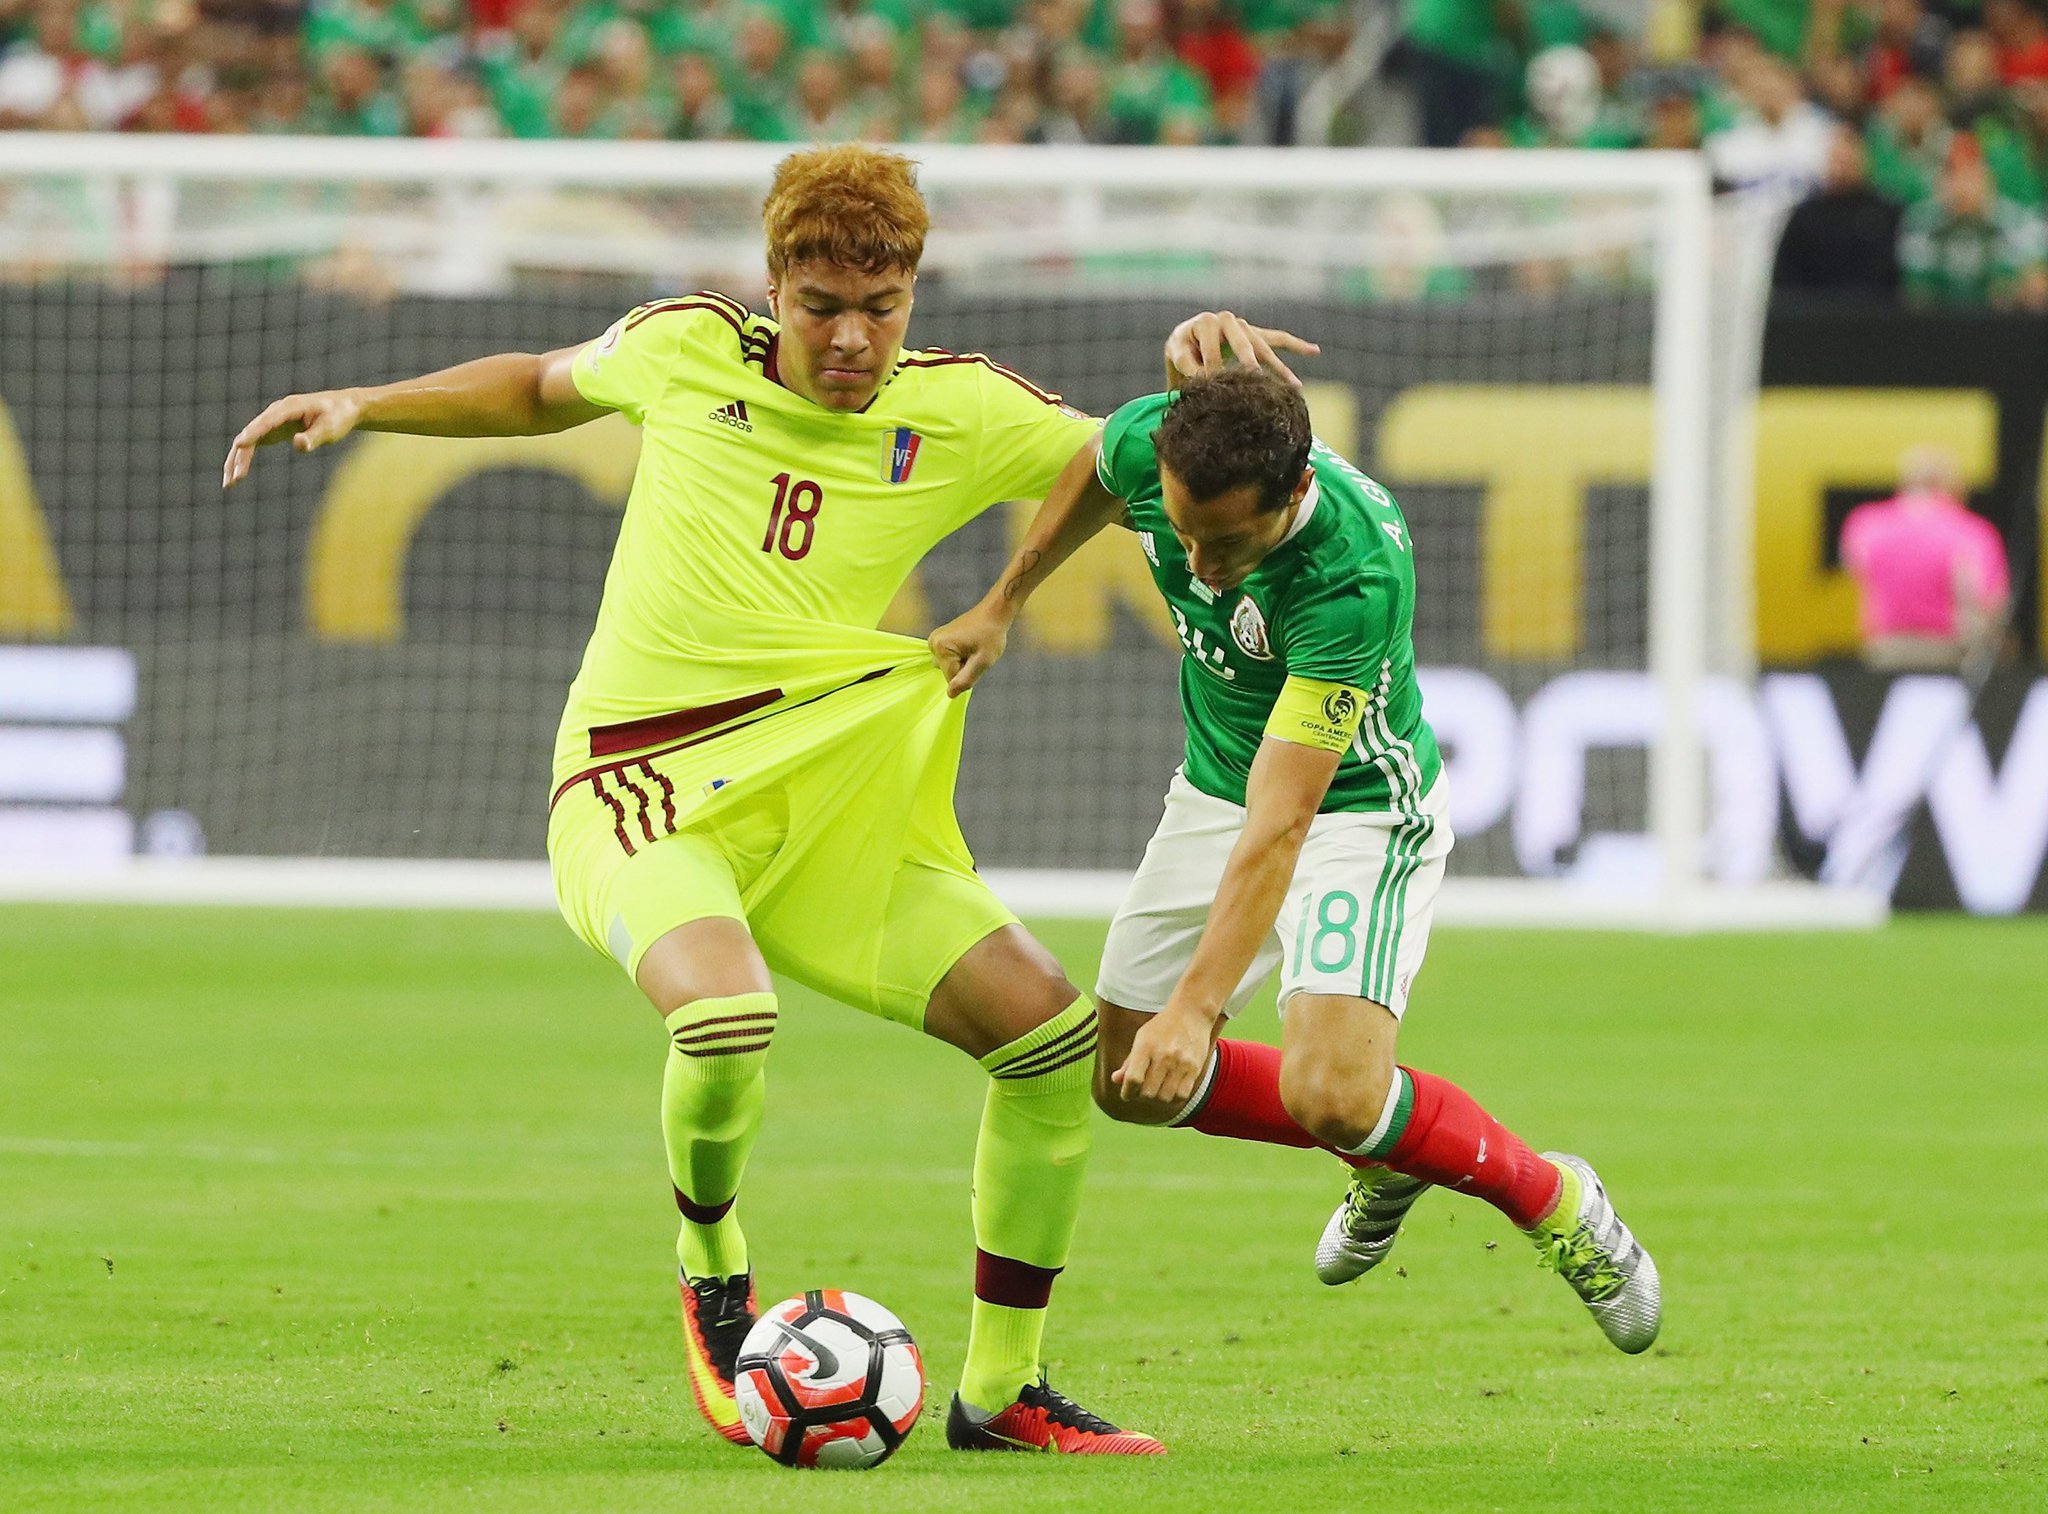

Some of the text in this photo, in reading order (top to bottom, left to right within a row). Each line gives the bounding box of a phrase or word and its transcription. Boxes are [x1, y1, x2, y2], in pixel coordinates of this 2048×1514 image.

[708, 411, 753, 433] adidas
[761, 472, 823, 561] 18
[1301, 720, 1325, 732] COPA
[1292, 889, 1360, 978] 18
